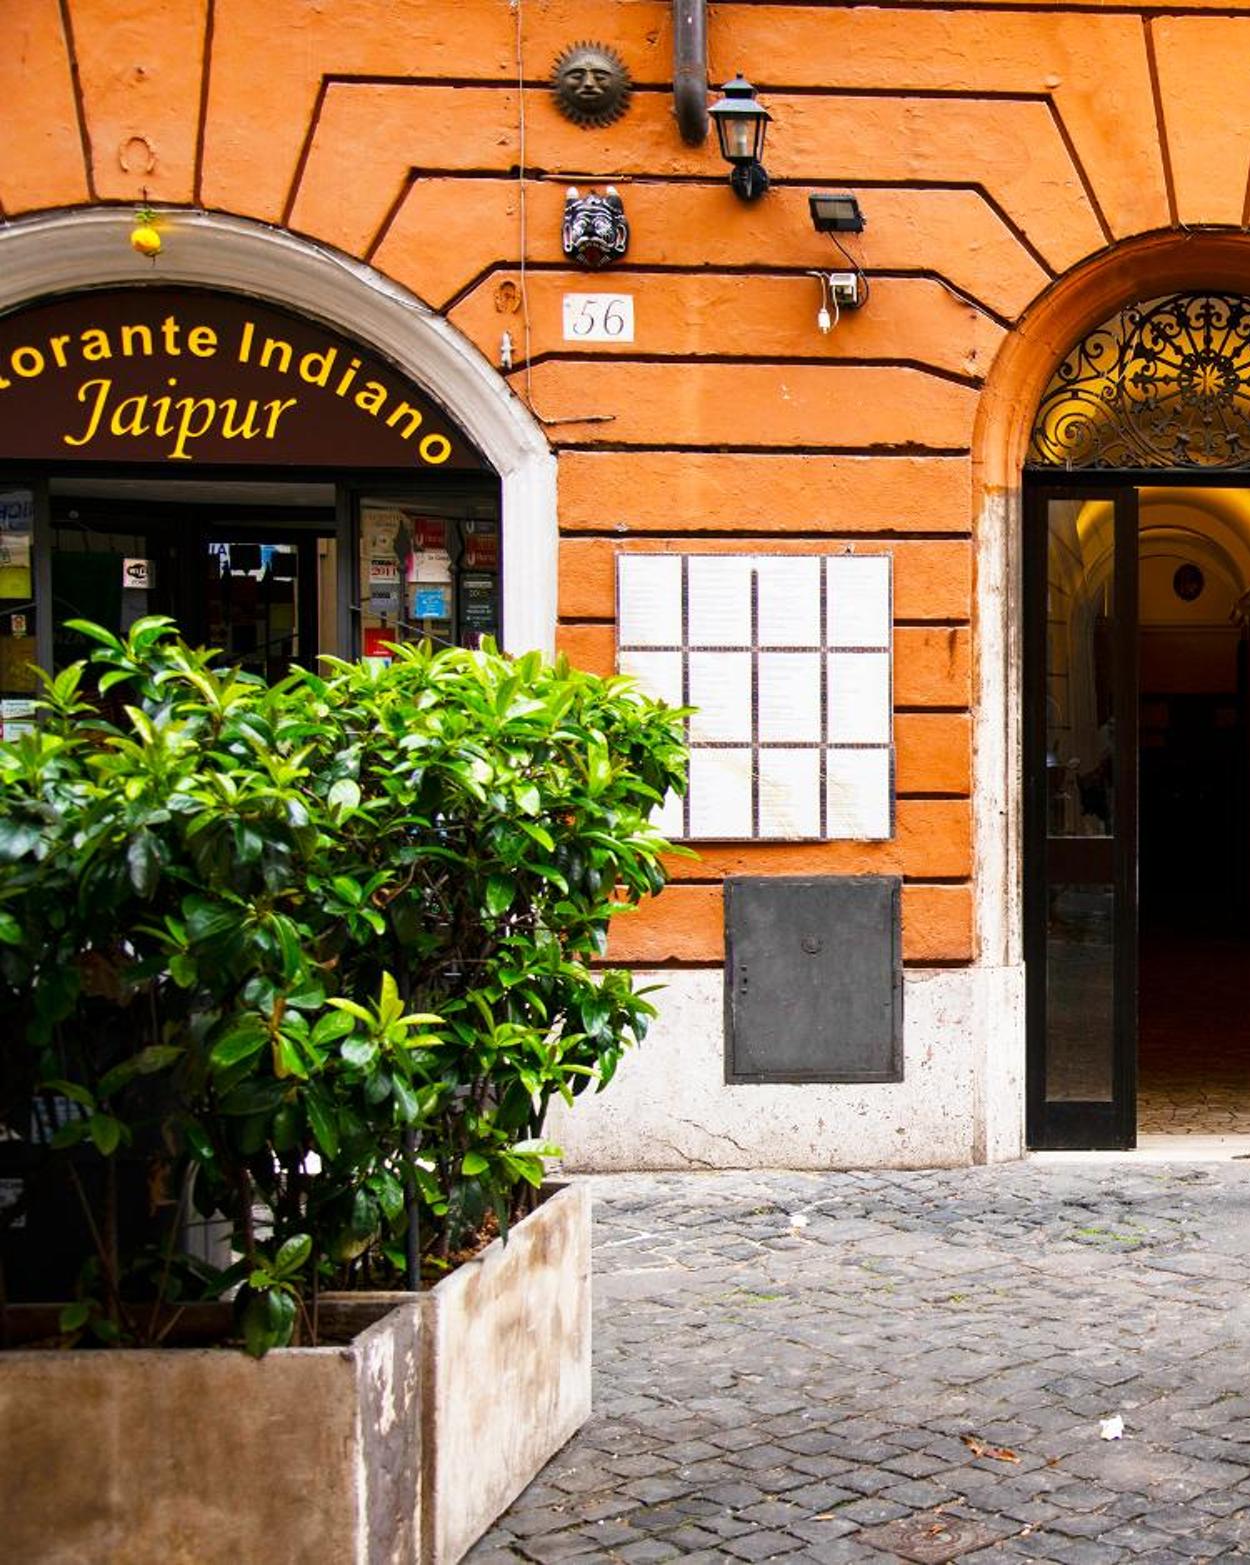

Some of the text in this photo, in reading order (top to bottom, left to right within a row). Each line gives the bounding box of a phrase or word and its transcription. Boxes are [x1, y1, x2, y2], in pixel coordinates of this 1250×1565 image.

[573, 301, 625, 336] 56
[0, 316, 452, 465] orante Indiano
[64, 378, 297, 459] Jaipur
